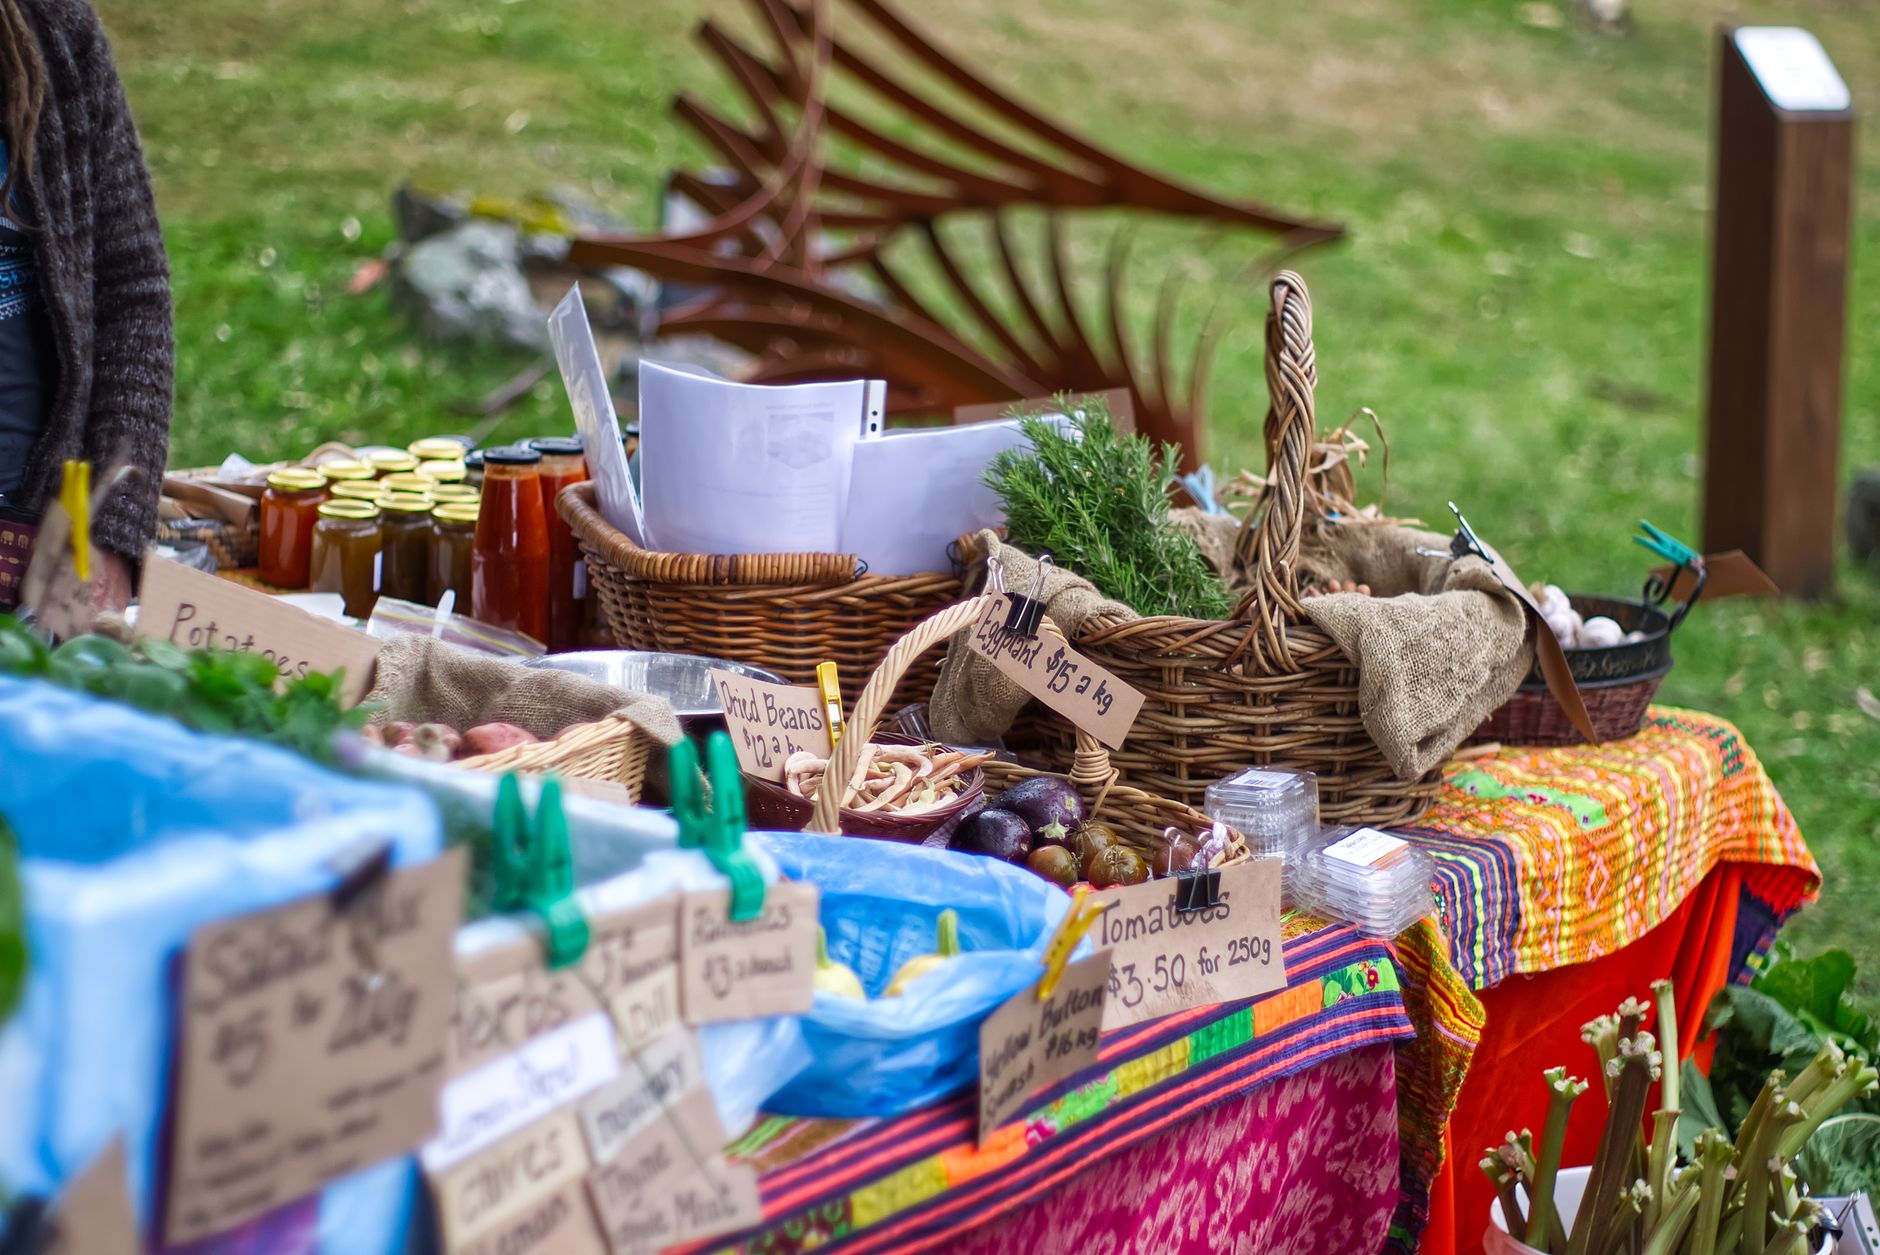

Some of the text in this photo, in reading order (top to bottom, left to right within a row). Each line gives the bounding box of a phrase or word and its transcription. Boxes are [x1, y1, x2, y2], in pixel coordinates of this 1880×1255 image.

[975, 599, 1115, 716] Eggplant $15 a kg
[719, 680, 823, 731] Dried Beans
[742, 726, 773, 768] $12
[771, 735, 782, 754] a
[1107, 935, 1271, 1009] $3.50 for 250g
